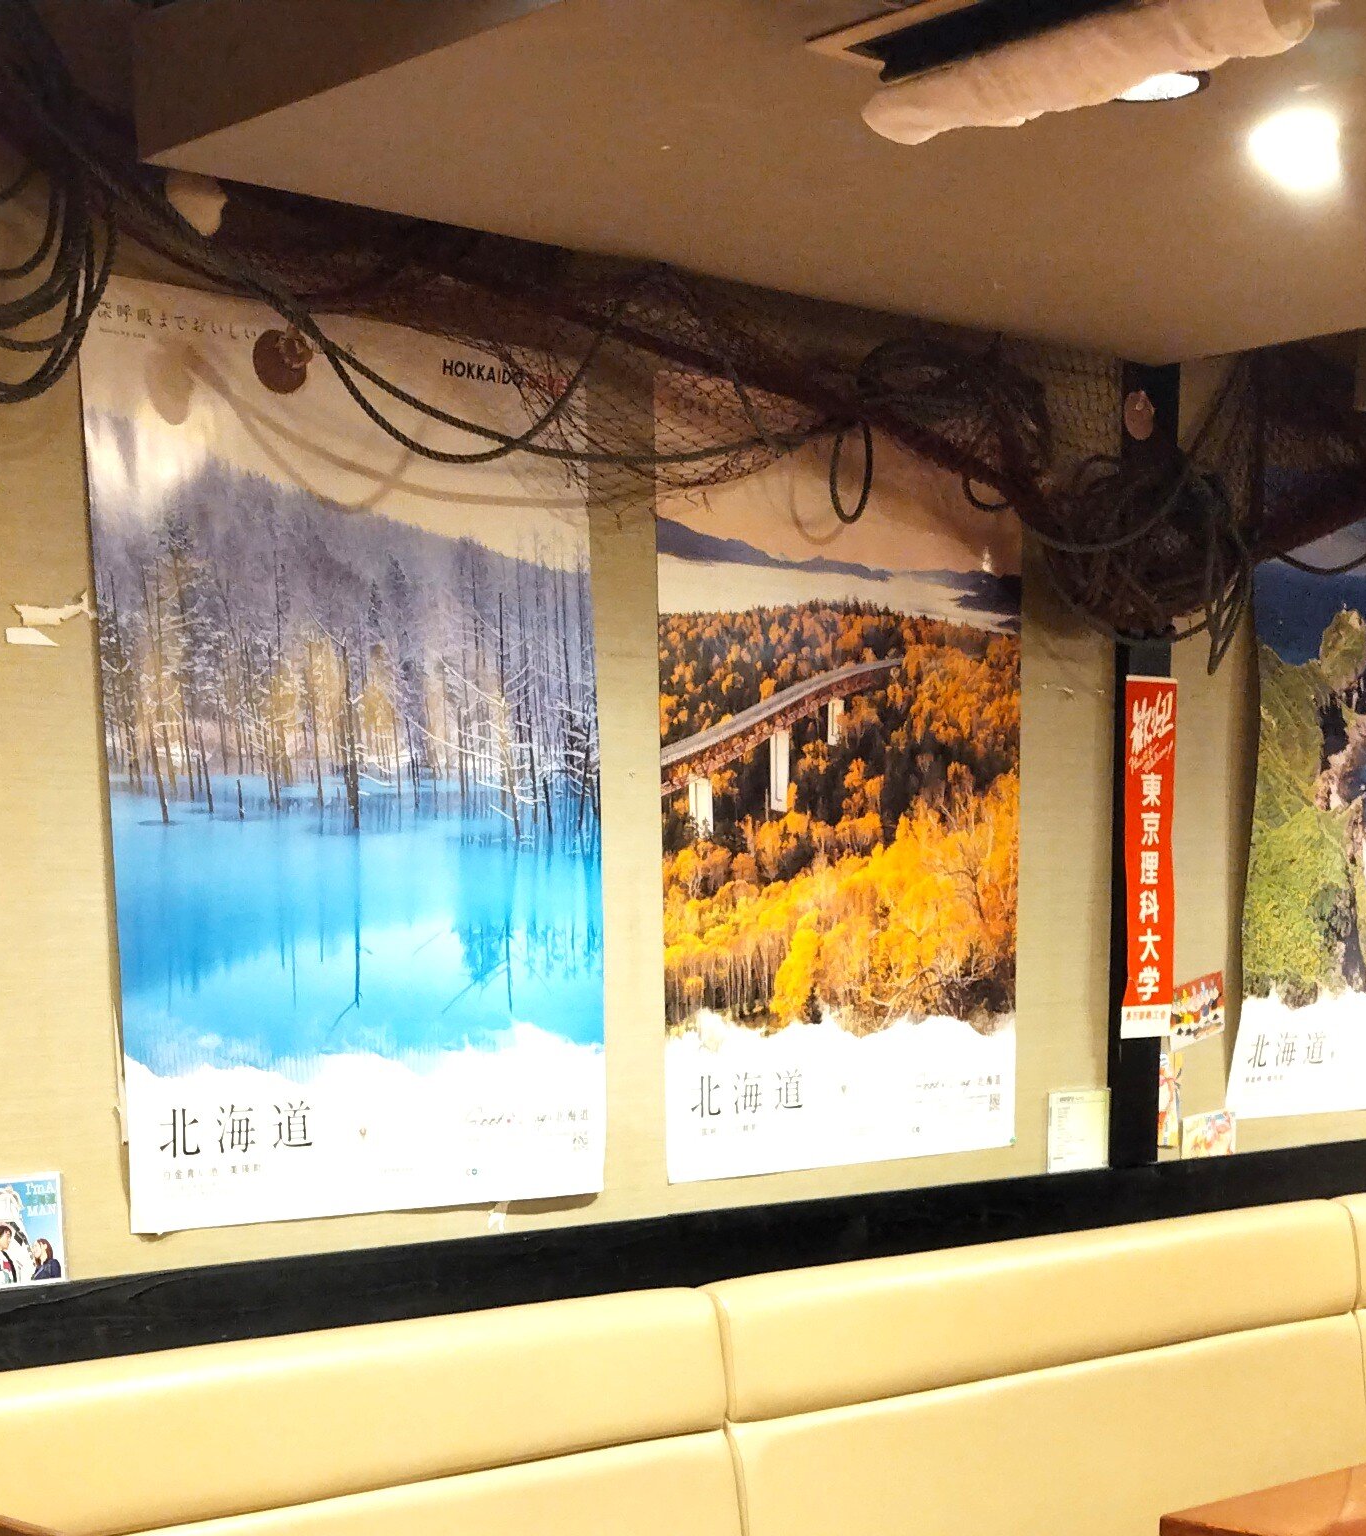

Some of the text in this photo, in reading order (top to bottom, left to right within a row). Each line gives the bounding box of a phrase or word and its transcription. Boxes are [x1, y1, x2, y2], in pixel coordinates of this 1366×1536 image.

[1135, 772, 1162, 1002] 東京理科大学
[1247, 1031, 1324, 1070] 北海道
[691, 1069, 803, 1119] 北海道
[159, 1100, 313, 1158] 北海道
[27, 1202, 56, 1217] MAN
